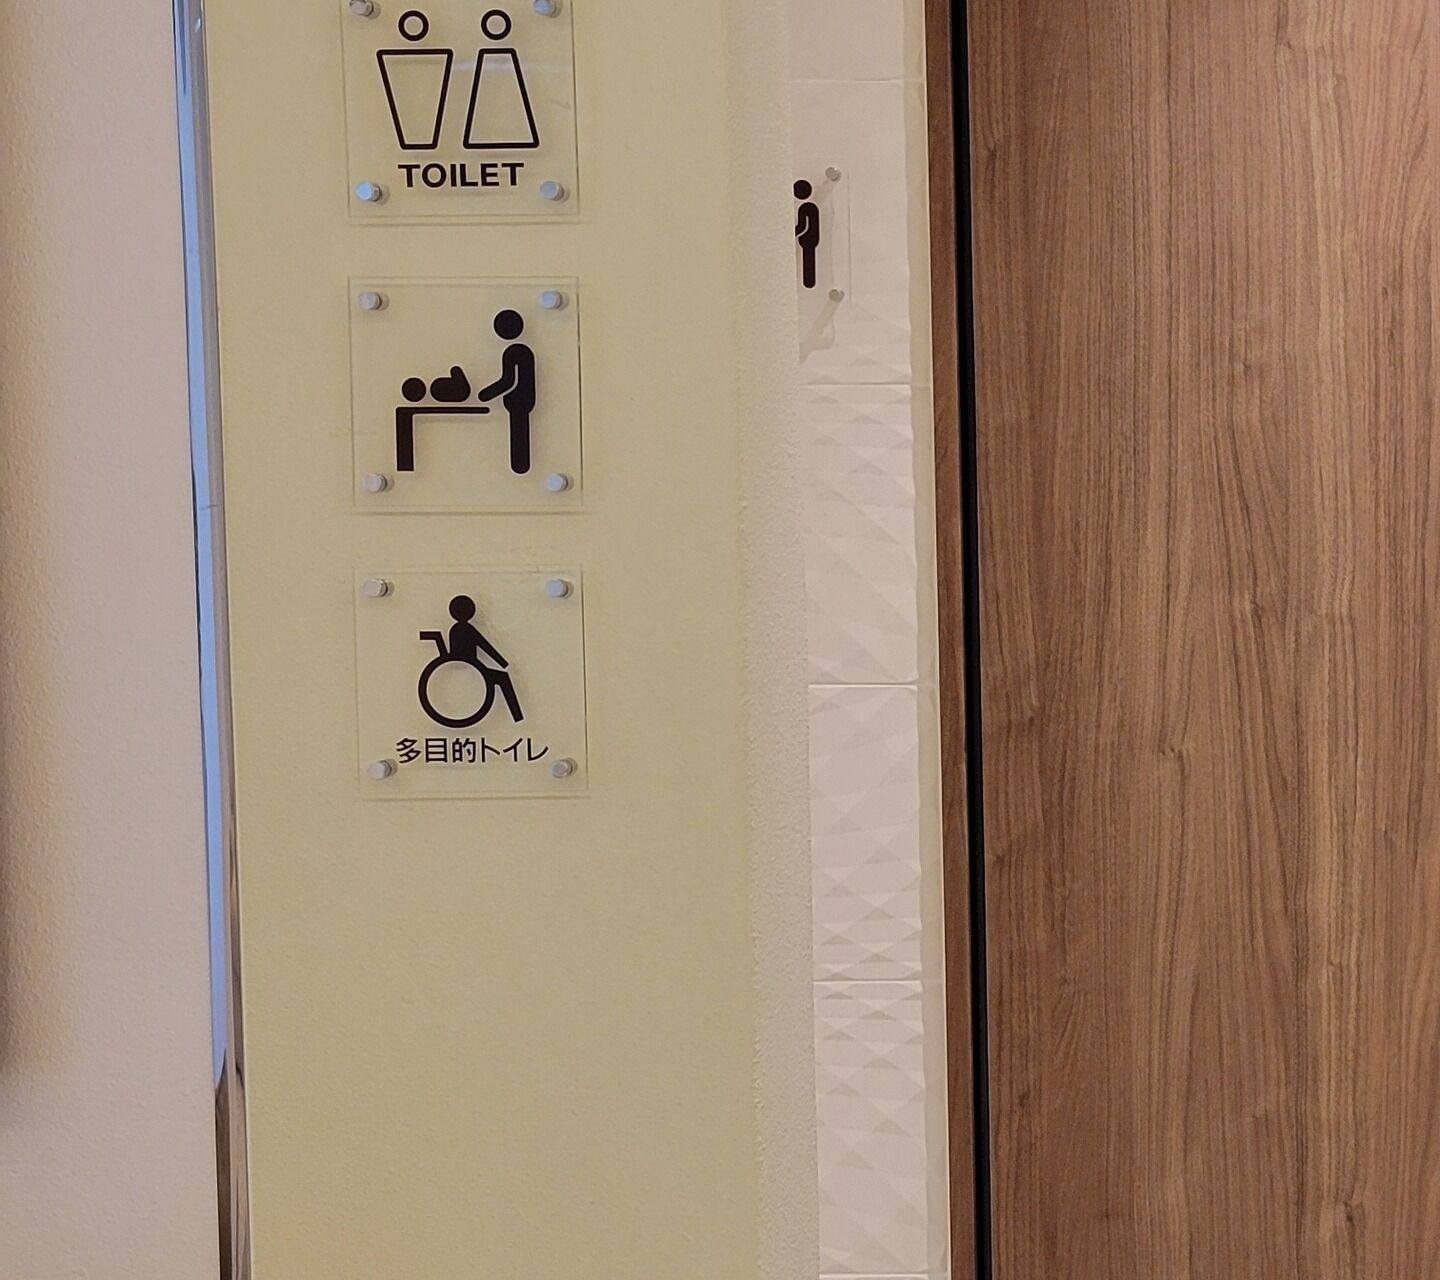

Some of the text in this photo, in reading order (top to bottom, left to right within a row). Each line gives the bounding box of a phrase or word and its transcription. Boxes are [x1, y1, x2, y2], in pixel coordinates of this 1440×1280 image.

[397, 162, 525, 189] TOILET
[396, 737, 549, 764] 多目的トイレ
